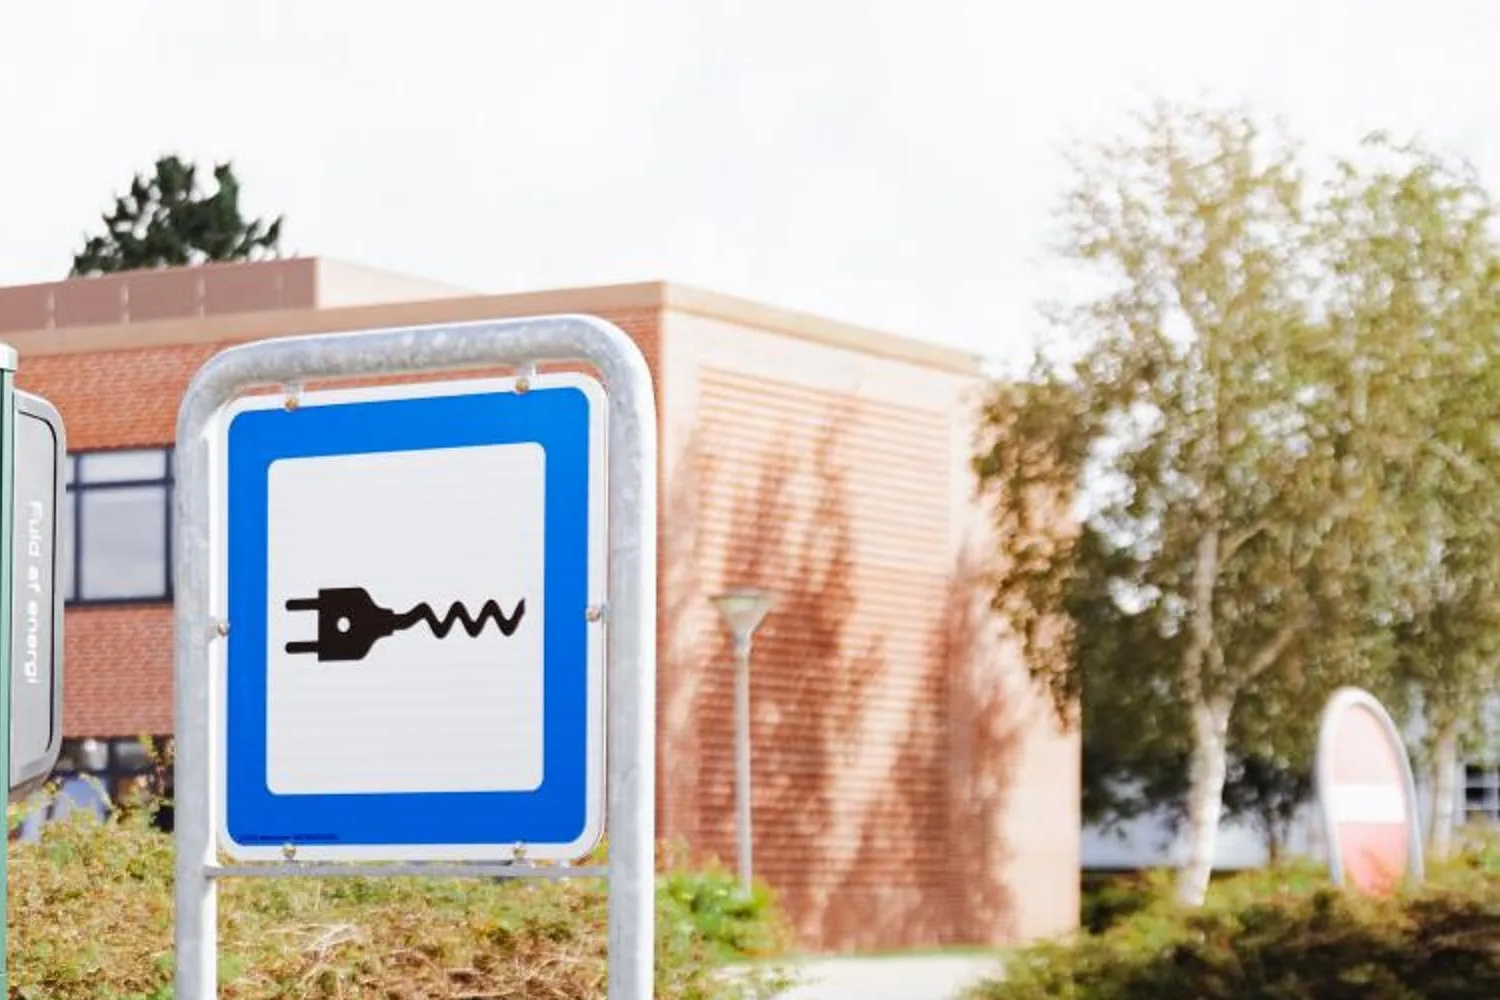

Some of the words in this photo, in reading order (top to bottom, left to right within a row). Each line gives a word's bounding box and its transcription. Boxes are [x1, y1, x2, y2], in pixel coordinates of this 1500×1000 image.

[27, 500, 43, 558] Fuld
[27, 564, 41, 593] af
[23, 600, 41, 685] energi
